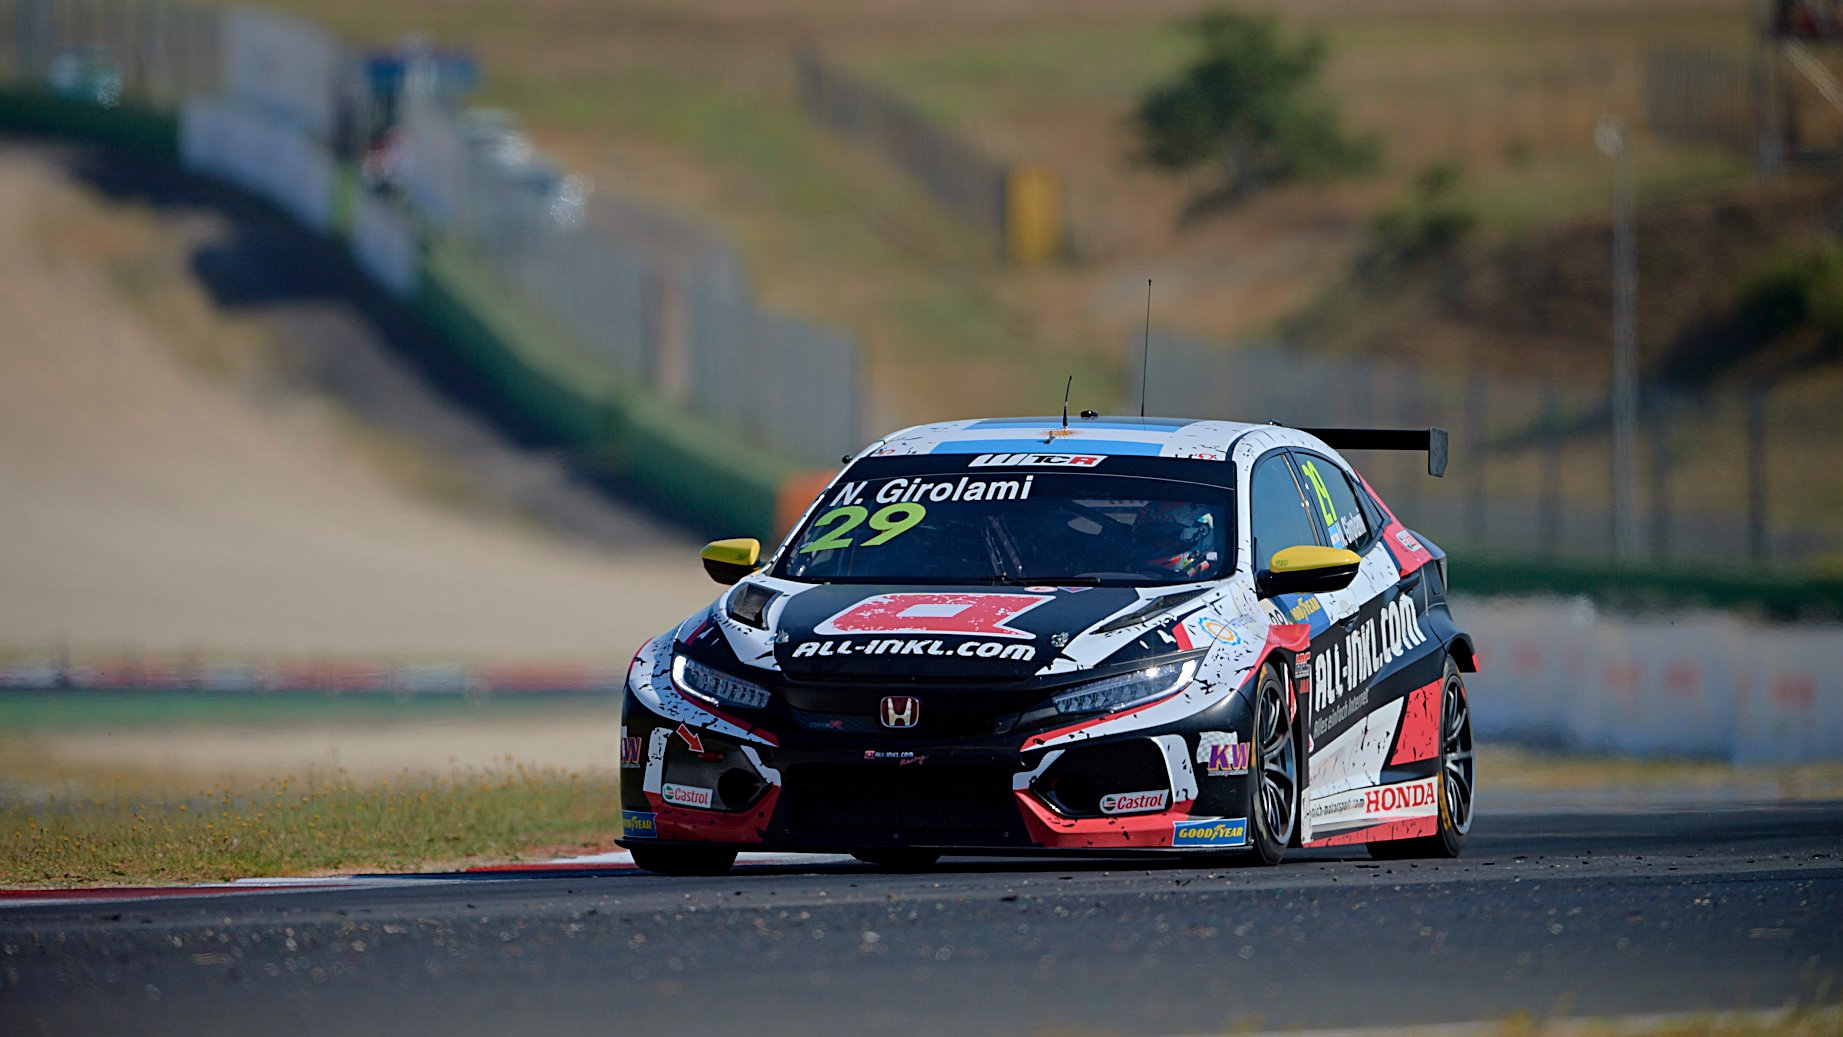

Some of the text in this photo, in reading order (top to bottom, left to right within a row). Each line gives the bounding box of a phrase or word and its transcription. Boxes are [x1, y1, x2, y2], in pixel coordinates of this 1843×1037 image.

[829, 475, 1034, 507] N. Girolami
[1302, 460, 1338, 527] 29
[799, 502, 927, 554] 29
[1207, 741, 1250, 770] KW
[674, 787, 709, 805] Castrol
[1117, 793, 1163, 810] Castrol
[1365, 782, 1436, 814] HONDA
[1178, 824, 1243, 841] GOODYEAR
